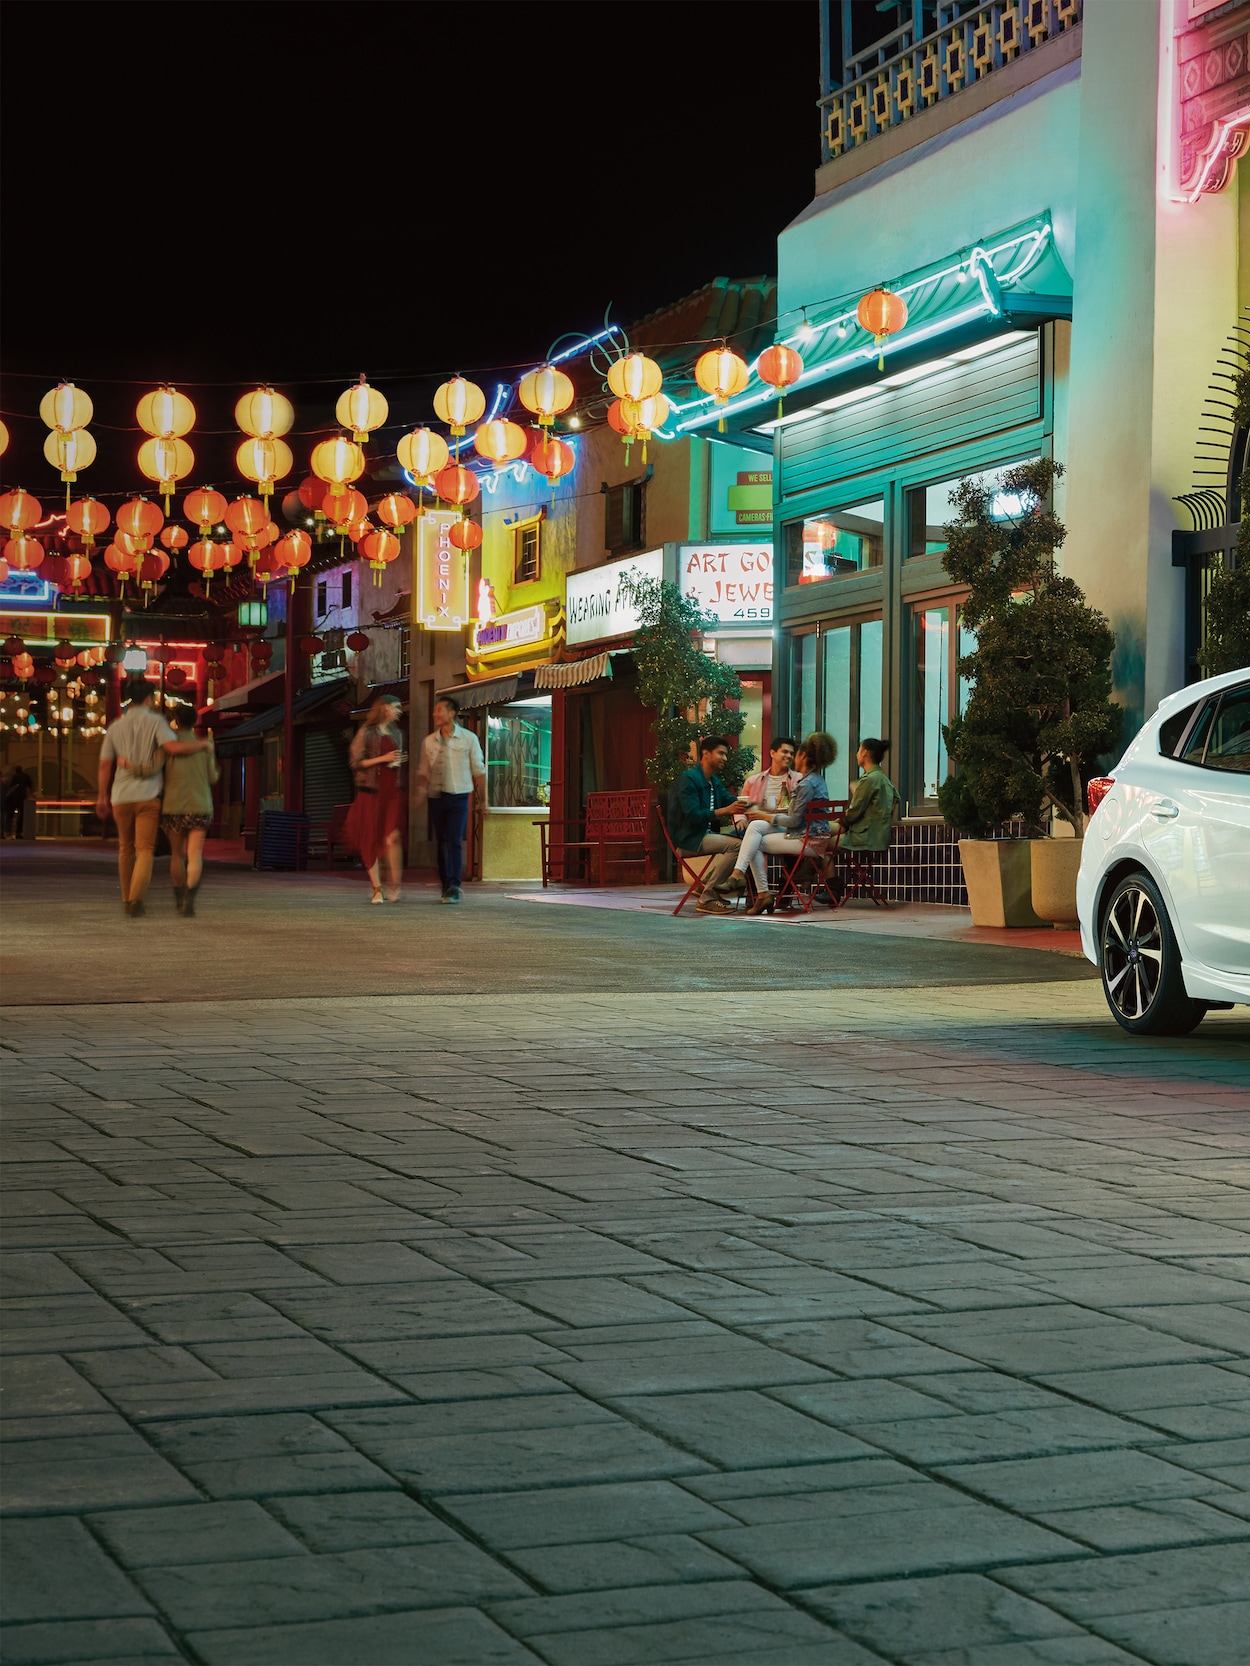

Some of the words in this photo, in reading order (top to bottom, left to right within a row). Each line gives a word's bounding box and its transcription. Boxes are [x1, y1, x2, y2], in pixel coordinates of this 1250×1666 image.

[748, 474, 758, 482] WE
[759, 473, 774, 482] SELL
[437, 523, 451, 618] PHOENIX
[687, 552, 731, 574] ART
[740, 551, 774, 573] GO
[709, 580, 774, 604] JEWE
[569, 589, 611, 624] WEARING
[733, 608, 770, 619] 459
